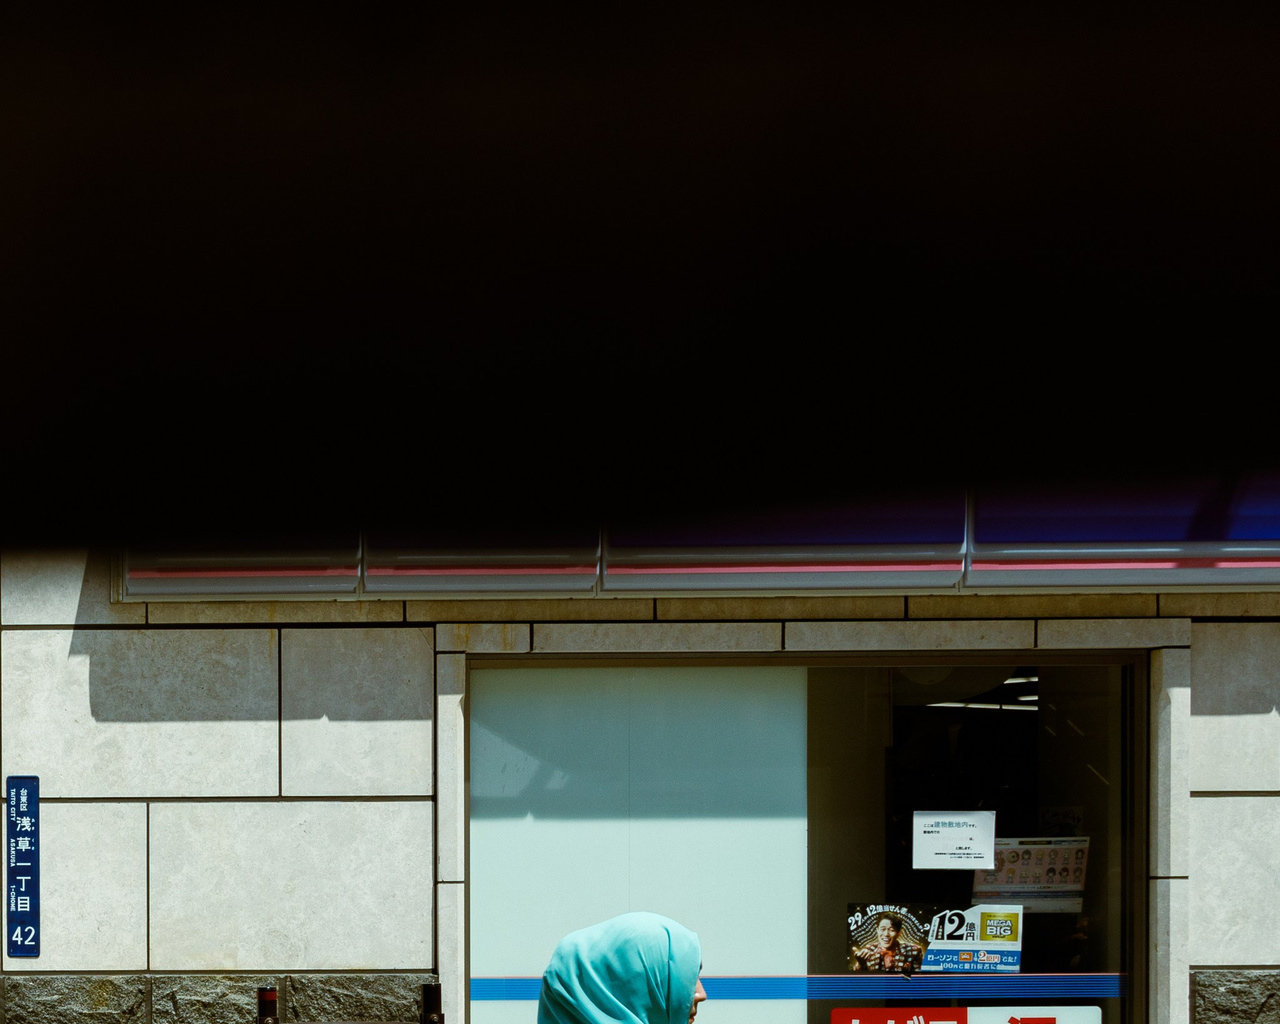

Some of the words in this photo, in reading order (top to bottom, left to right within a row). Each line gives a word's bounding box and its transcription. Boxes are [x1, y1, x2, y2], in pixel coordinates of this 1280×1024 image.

[20, 788, 28, 811] 台東区
[16, 816, 31, 912] 浅草一丁目
[986, 919, 1012, 927] MEGA
[986, 926, 1012, 935] BIG
[11, 926, 36, 945] 42
